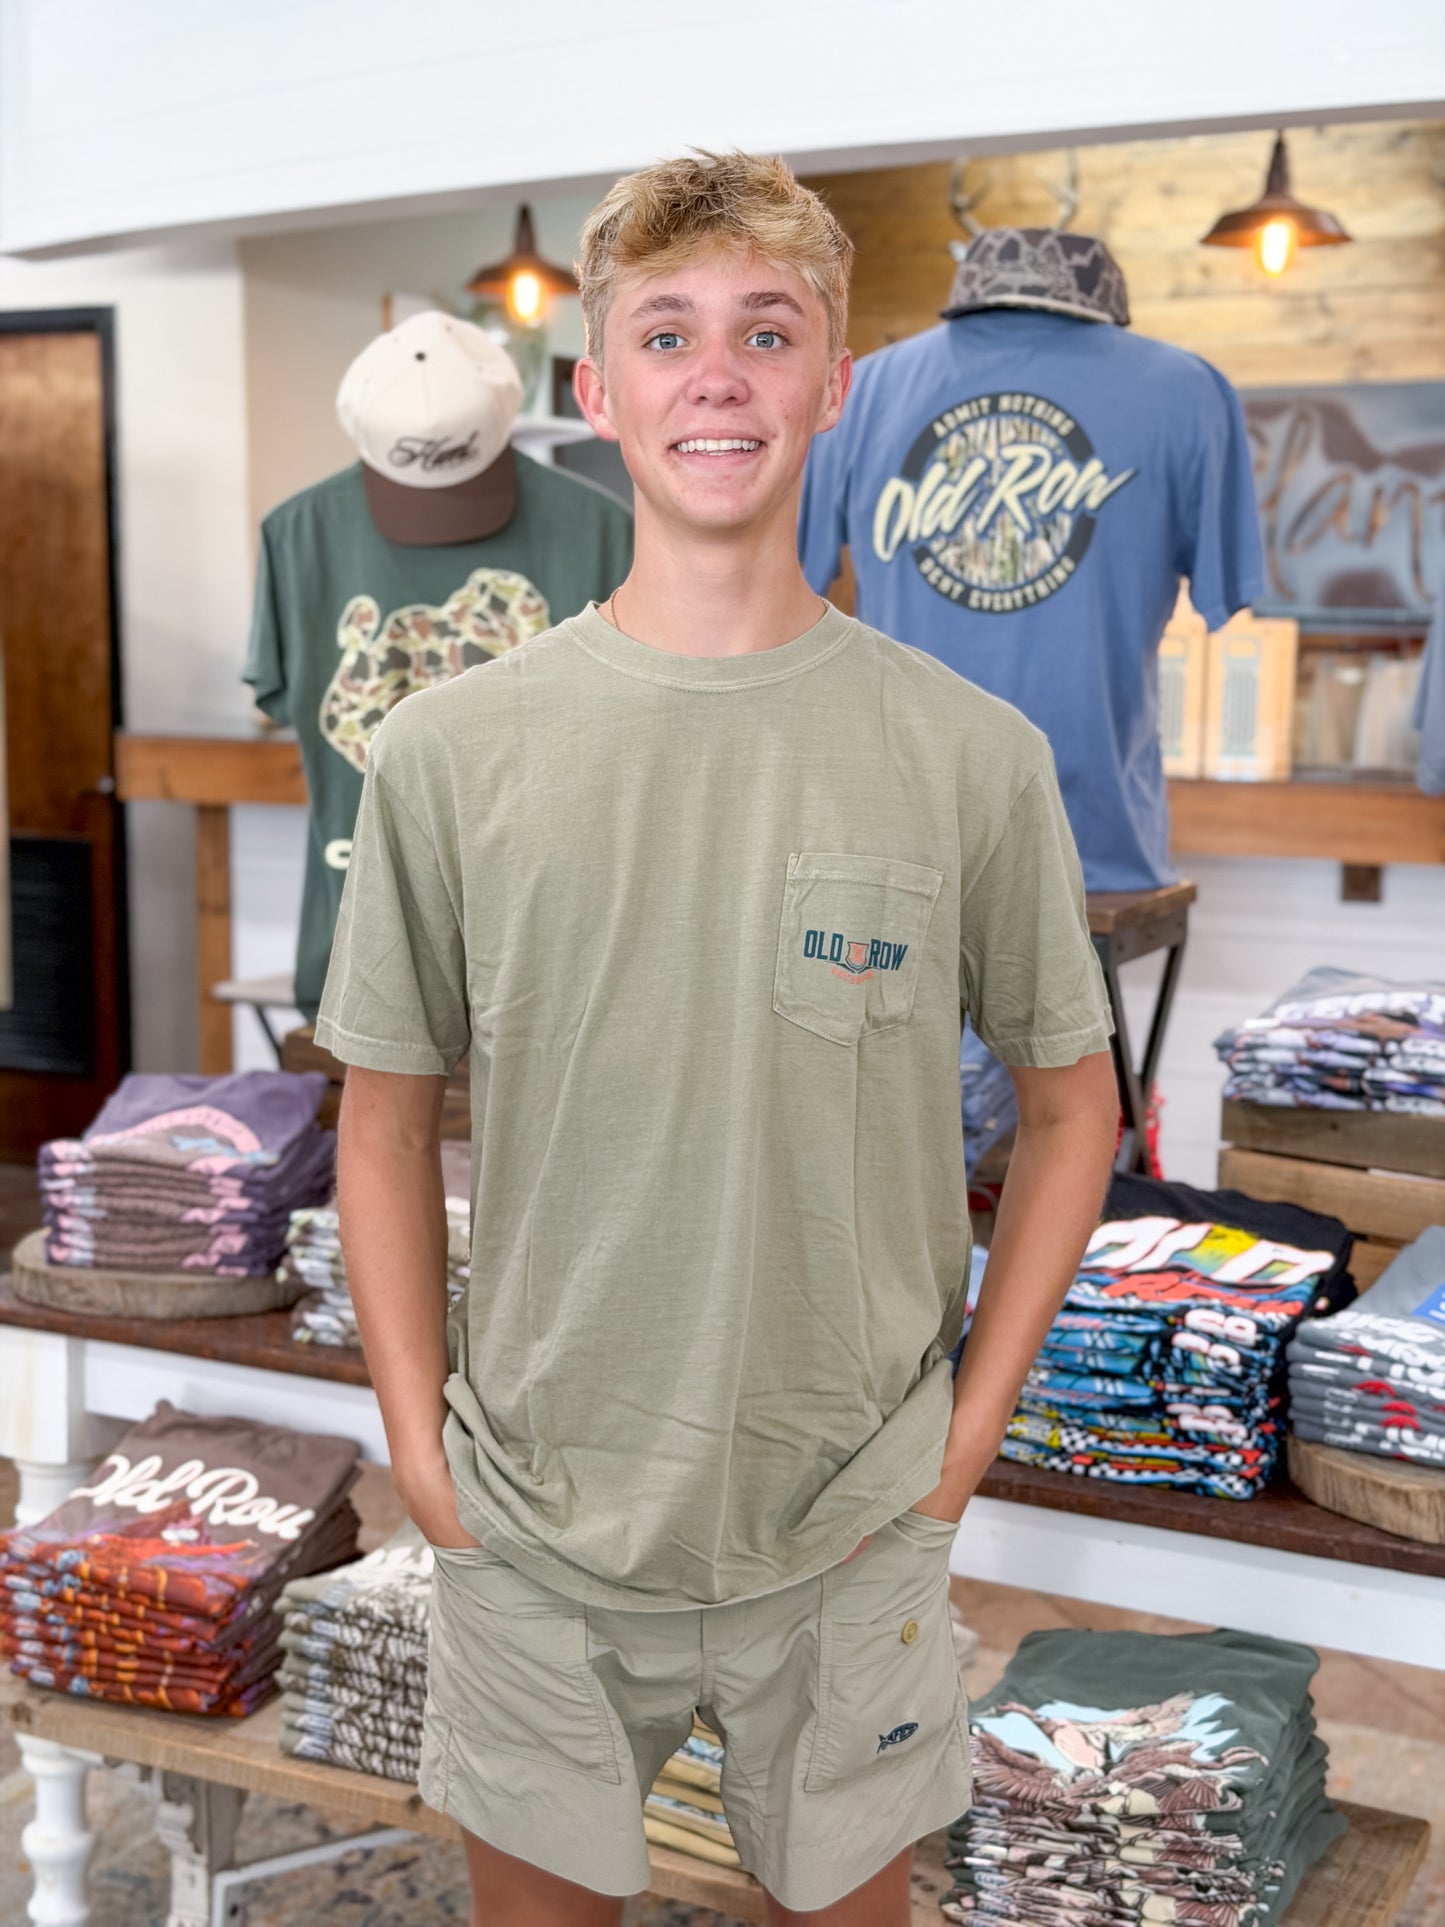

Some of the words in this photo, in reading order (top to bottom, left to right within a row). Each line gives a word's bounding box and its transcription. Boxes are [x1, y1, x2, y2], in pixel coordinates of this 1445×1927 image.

[932, 396, 991, 438] ADMIT
[998, 393, 1076, 437] NOTHING
[872, 457, 988, 562] Old
[976, 443, 1138, 534] Row
[919, 556, 965, 600] DENY
[967, 555, 1076, 612] EVERYTHING
[803, 928, 844, 962] OLD
[868, 938, 909, 971] ROW
